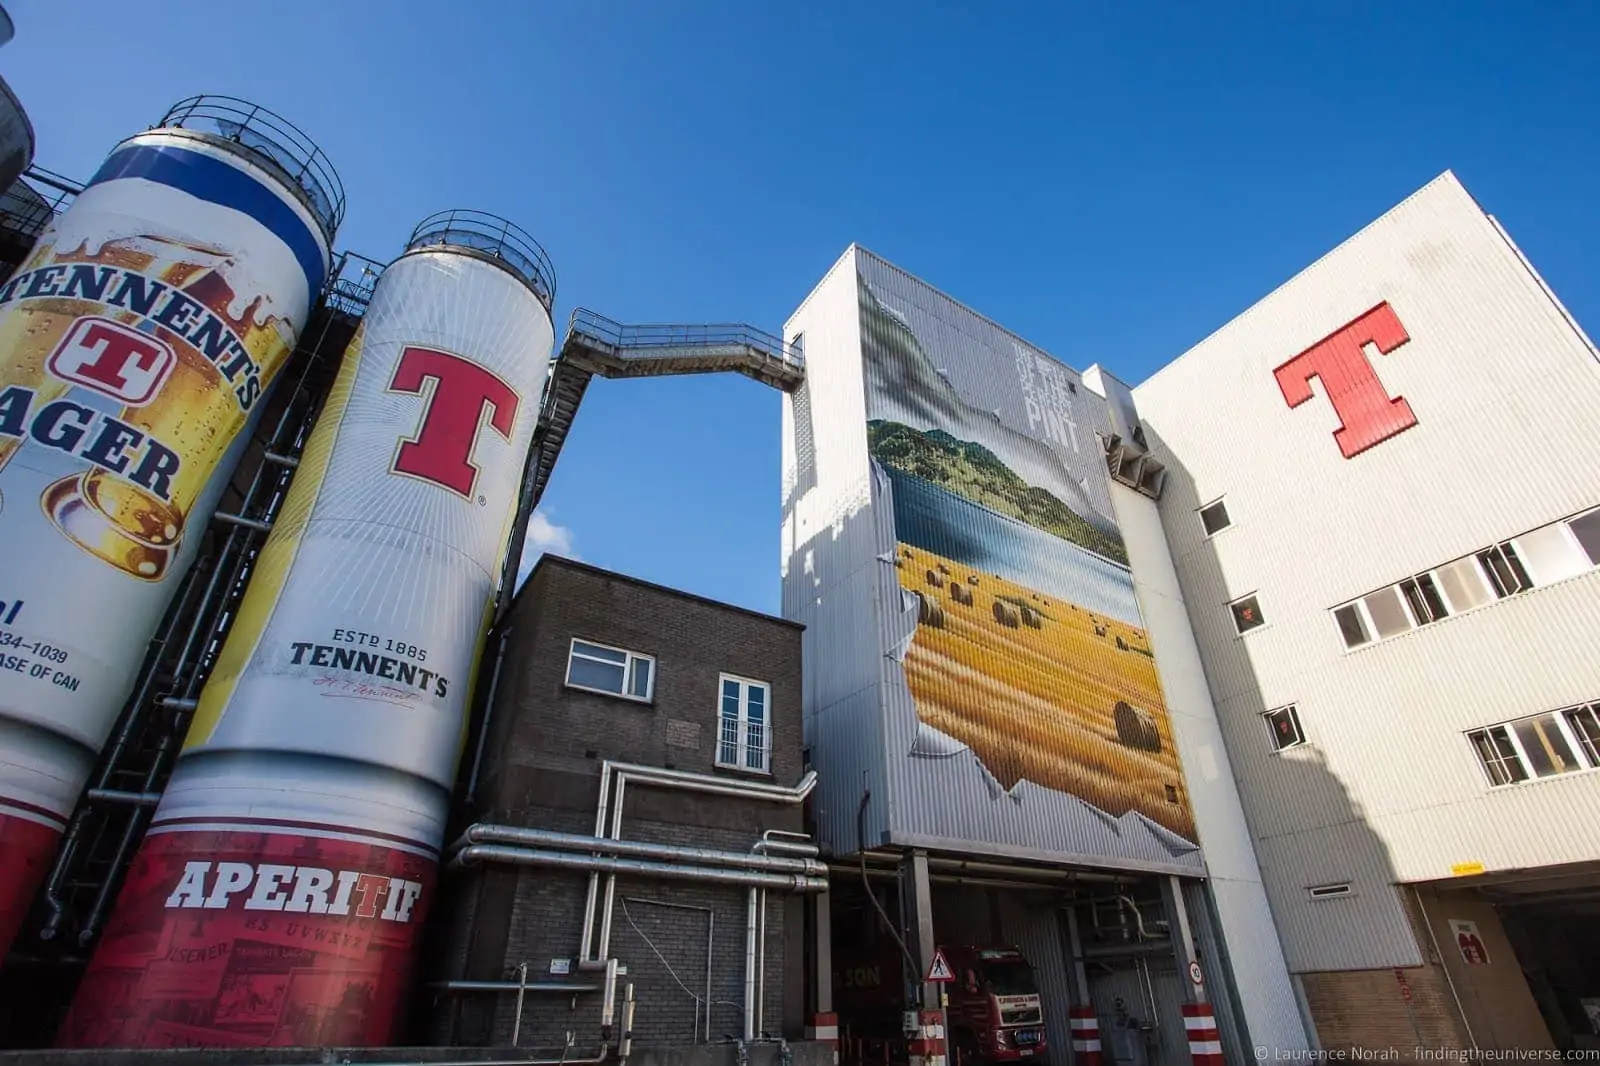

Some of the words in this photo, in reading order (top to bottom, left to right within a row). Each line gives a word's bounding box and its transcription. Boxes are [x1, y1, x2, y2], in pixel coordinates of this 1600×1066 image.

[76, 323, 161, 389] T
[1273, 300, 1419, 459] T
[388, 345, 521, 502] T
[1024, 396, 1081, 455] PINT
[30, 663, 52, 680] OF
[52, 671, 81, 692] CAN
[290, 641, 449, 699] TENNENT'S
[385, 639, 428, 662] 1885
[164, 860, 423, 923] APERITIF
